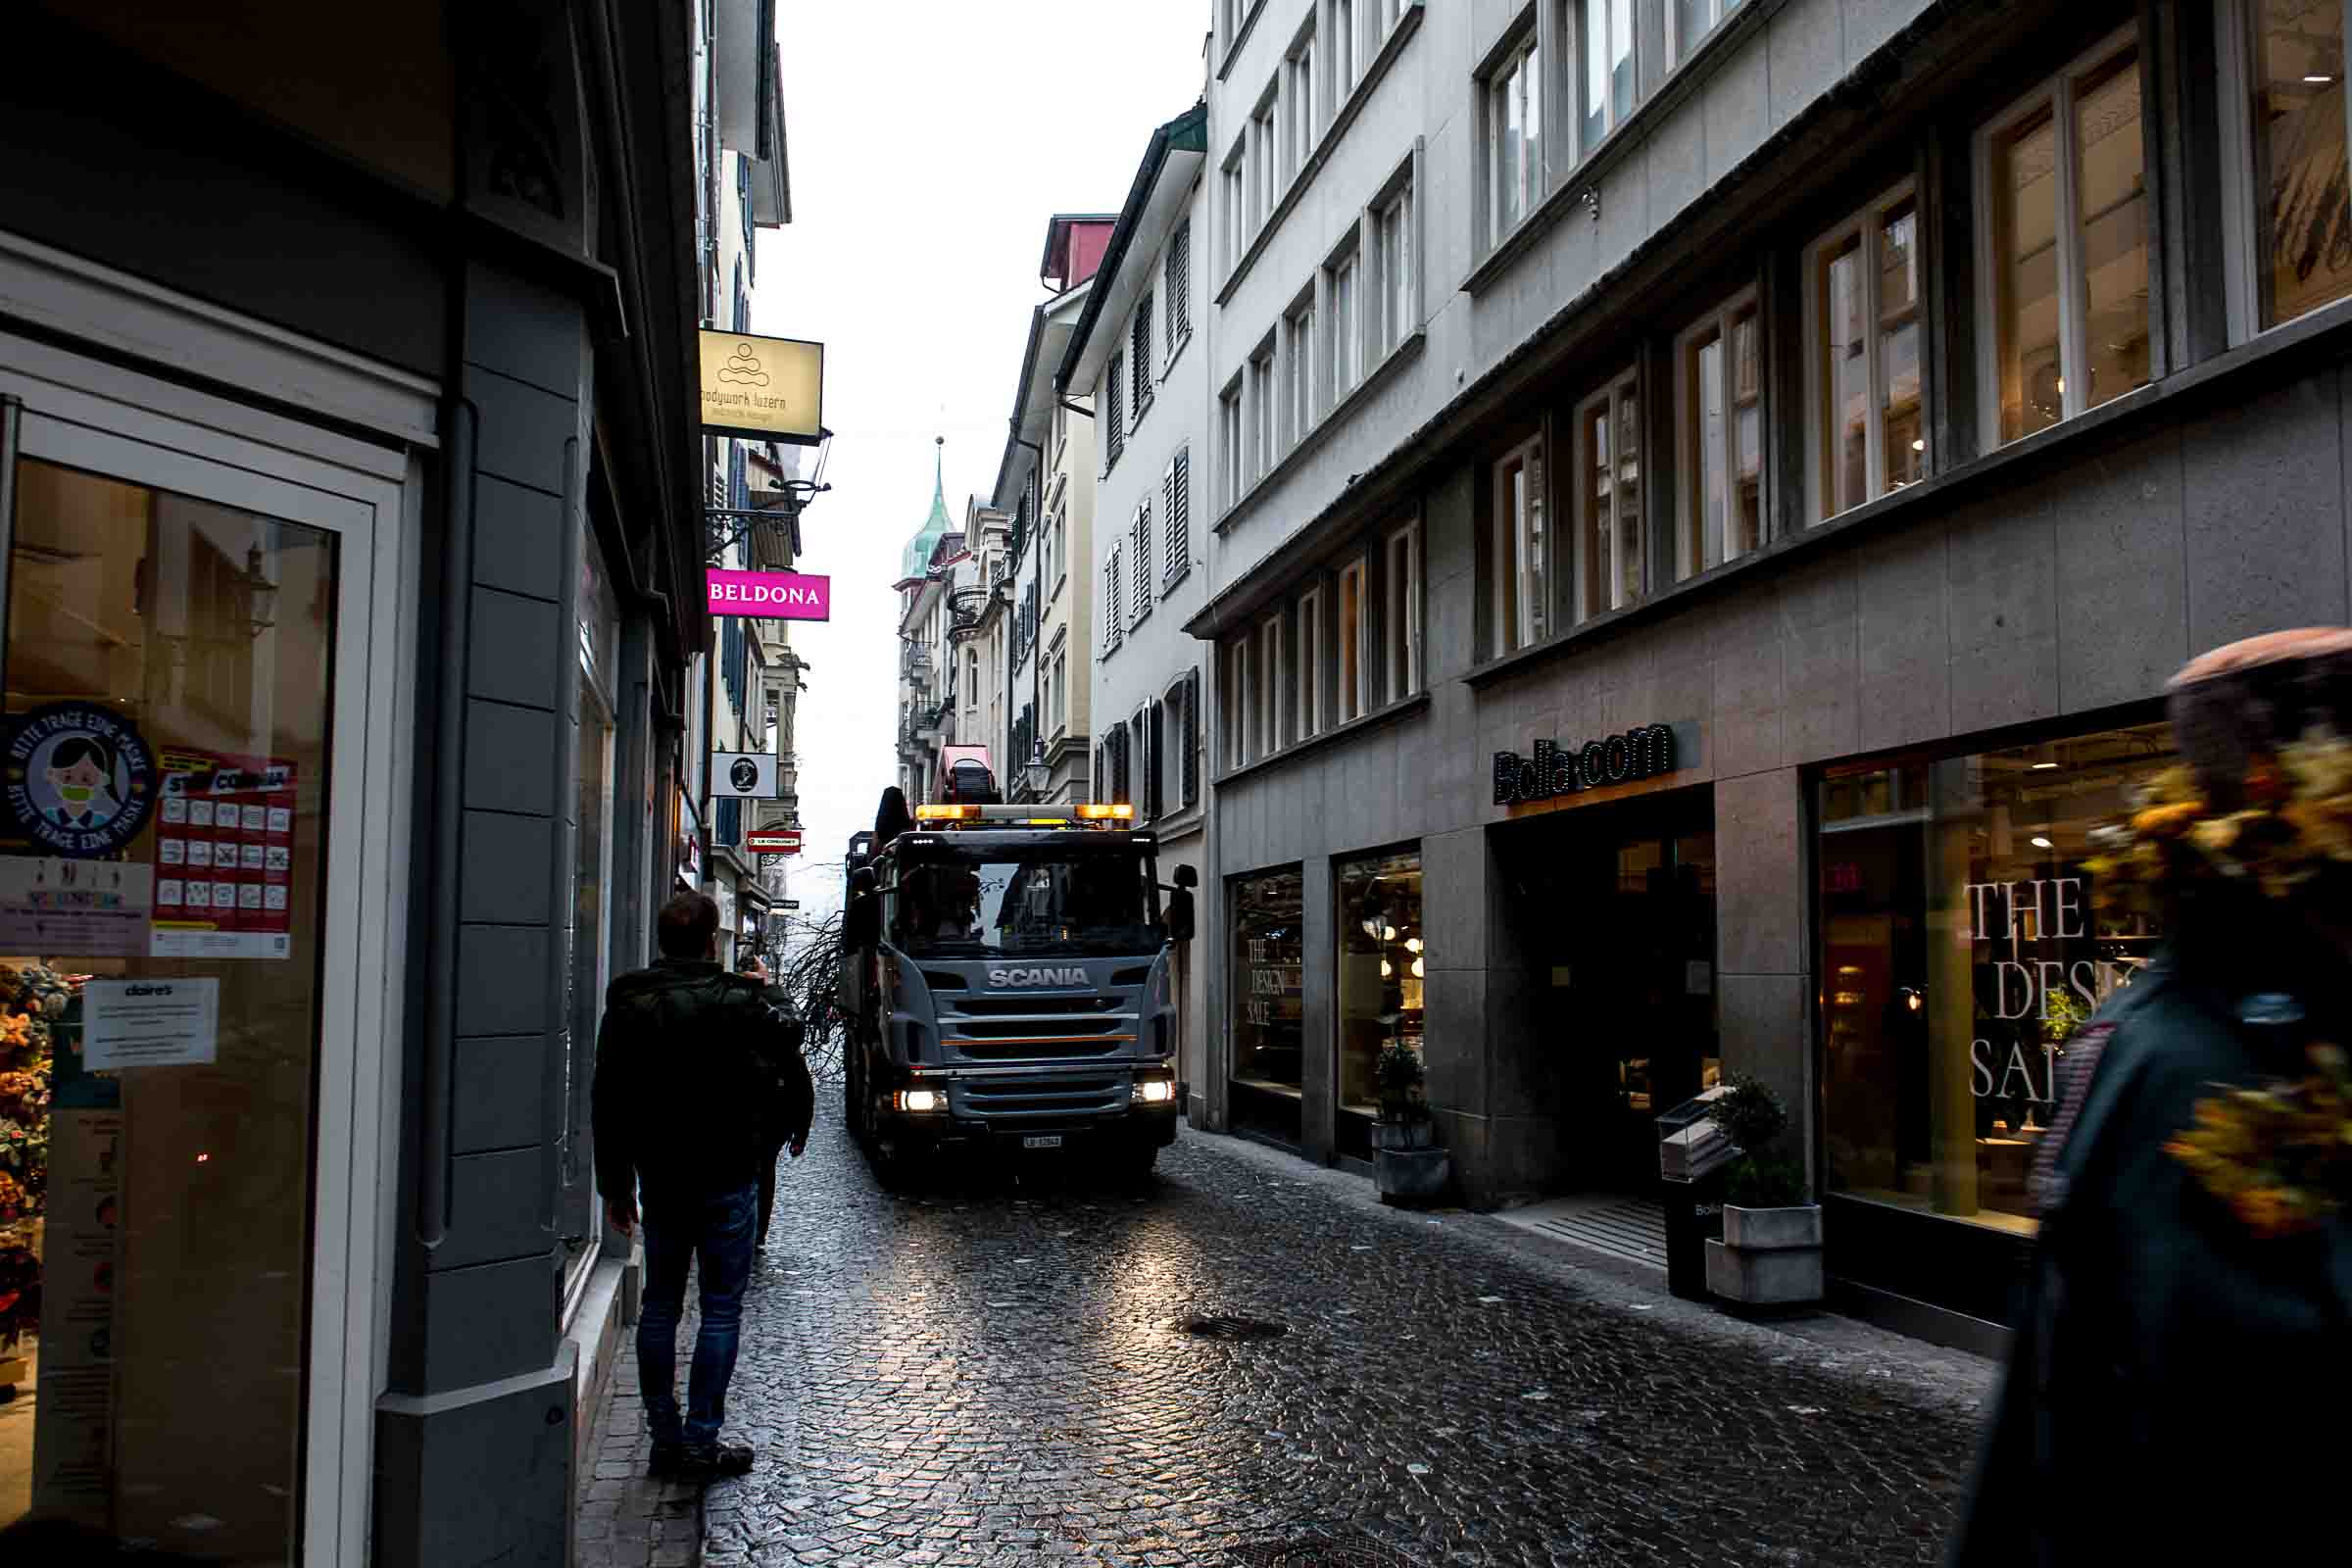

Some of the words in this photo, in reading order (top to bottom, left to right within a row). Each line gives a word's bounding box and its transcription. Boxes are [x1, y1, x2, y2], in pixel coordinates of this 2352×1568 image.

[754, 390, 787, 409] luzern
[710, 583, 819, 605] BELDONA
[1963, 877, 2084, 941] THE
[988, 968, 1091, 989] SCANIA
